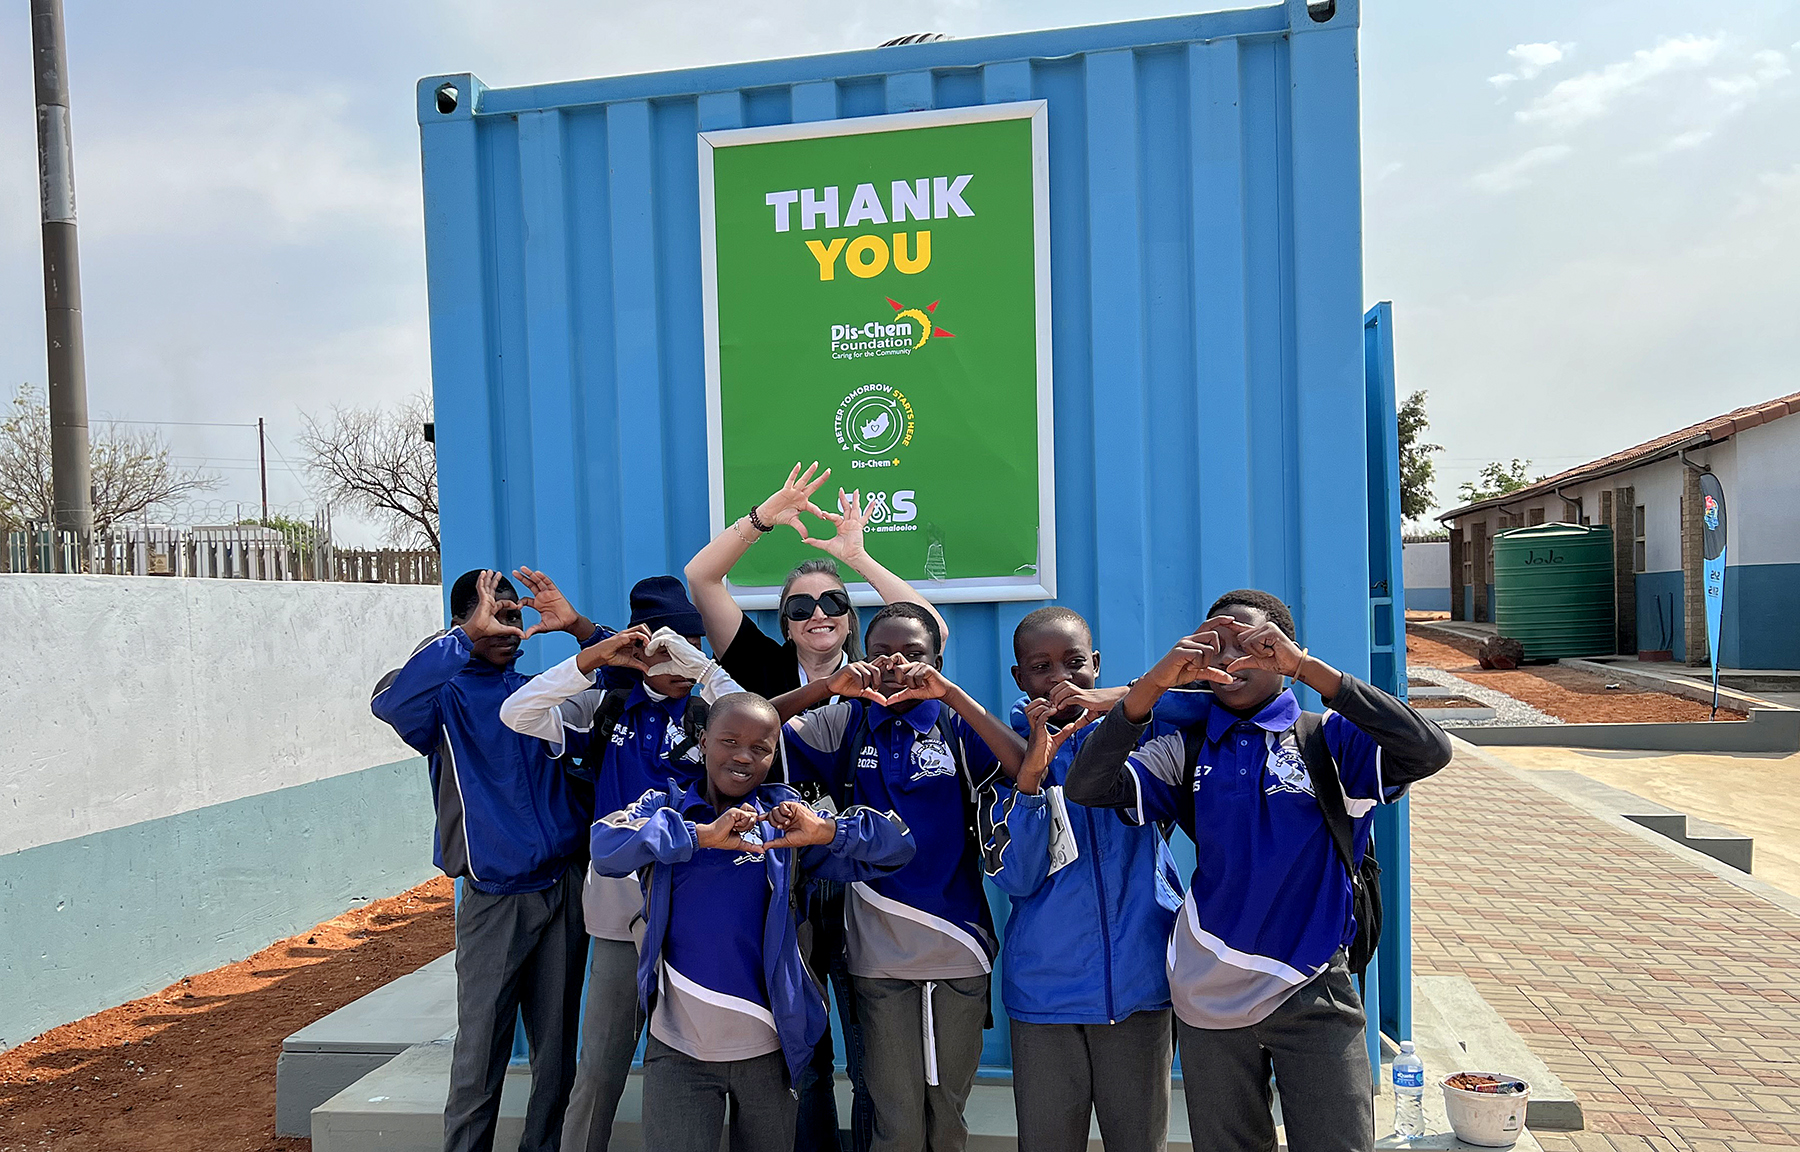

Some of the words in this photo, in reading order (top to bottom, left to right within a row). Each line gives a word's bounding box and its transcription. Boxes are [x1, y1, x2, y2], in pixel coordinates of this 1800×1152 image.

[765, 174, 976, 233] THANK
[804, 230, 932, 282] YOU
[831, 321, 912, 341] Dis-Chem
[831, 338, 913, 352] Foundation
[831, 352, 853, 360] Caring
[853, 351, 863, 359] for
[864, 350, 875, 358] the
[875, 348, 912, 356] Community
[840, 383, 893, 408] TOMORROW
[892, 389, 915, 420] STARTS
[834, 408, 845, 445] BETTER
[901, 421, 915, 447] HERE
[841, 443, 850, 451] A
[851, 459, 891, 469] Dis-Chem
[1525, 549, 1564, 565] JoJo
